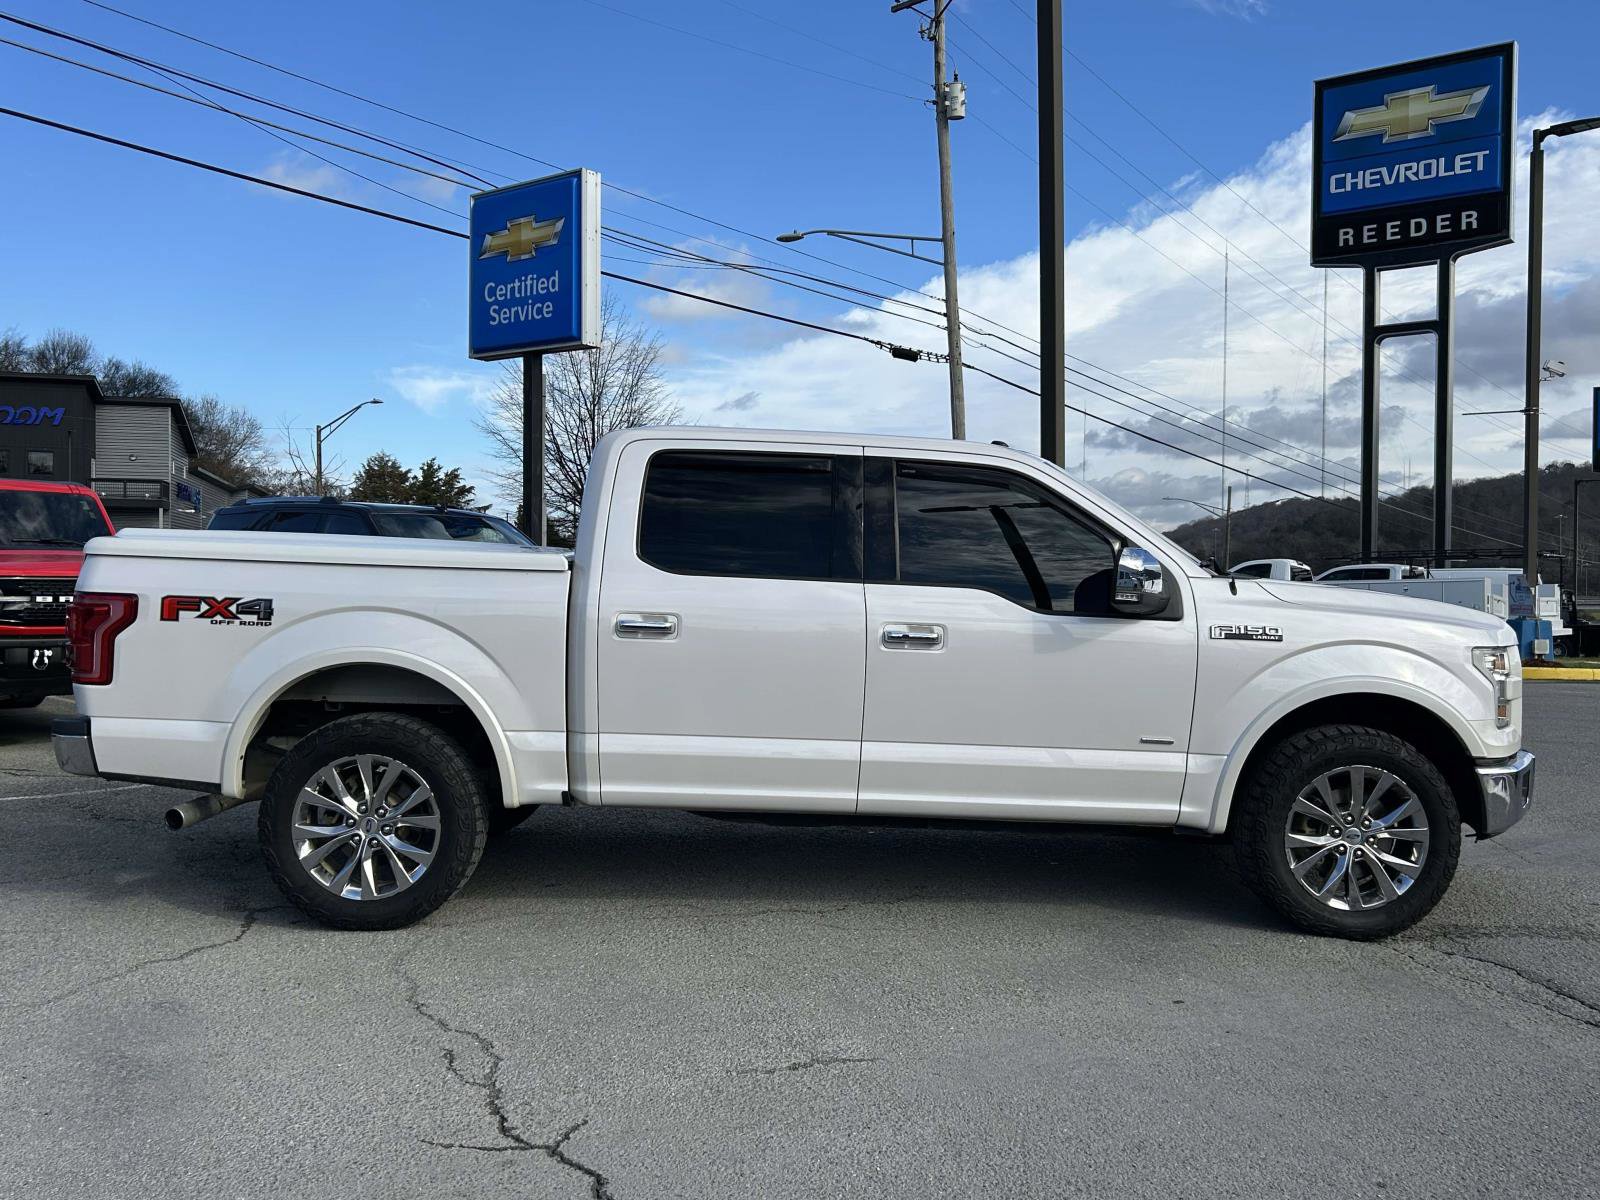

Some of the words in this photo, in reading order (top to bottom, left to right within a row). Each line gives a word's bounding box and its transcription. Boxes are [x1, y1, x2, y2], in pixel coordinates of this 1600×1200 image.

[1330, 151, 1489, 193] CHEVROLET
[1338, 210, 1478, 247] REEDER
[485, 270, 558, 302] Certified
[489, 300, 553, 325] Service
[160, 595, 274, 622] FX4
